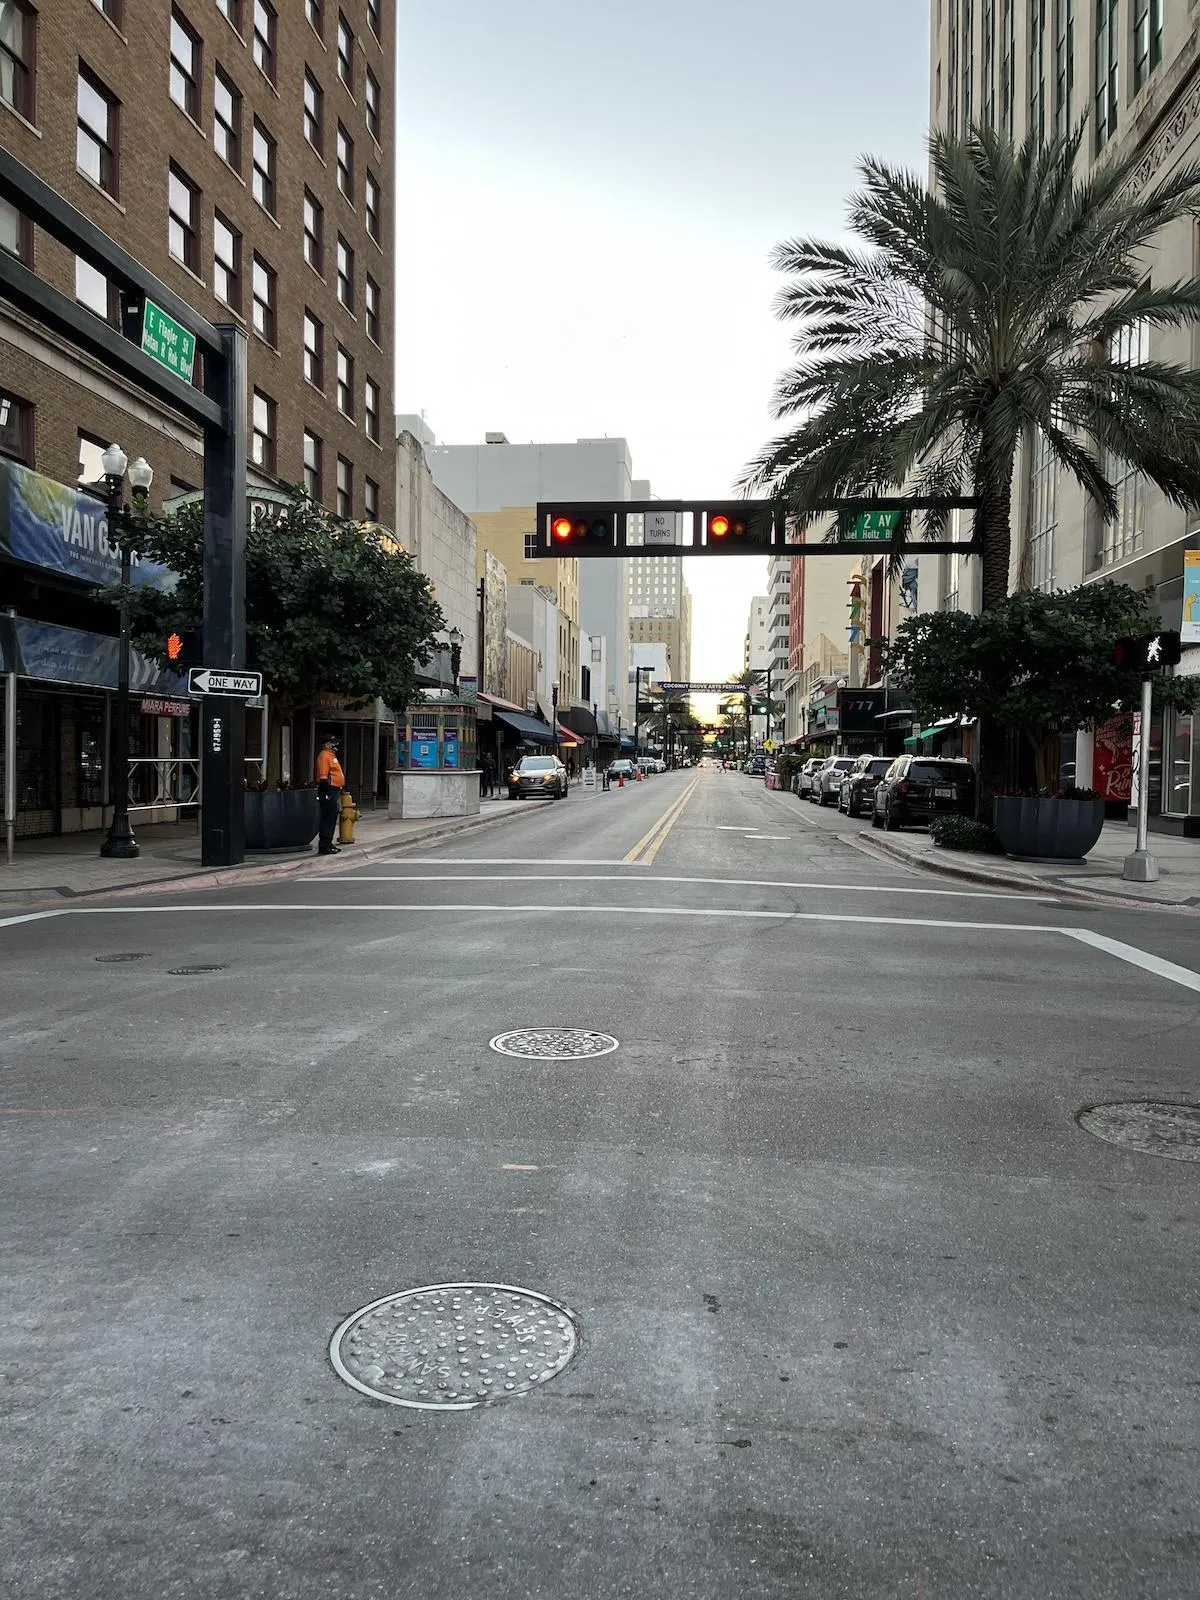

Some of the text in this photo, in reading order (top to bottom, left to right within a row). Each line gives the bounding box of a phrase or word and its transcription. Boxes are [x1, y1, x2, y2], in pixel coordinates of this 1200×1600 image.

[149, 311, 189, 355] E Flagler St
[160, 341, 166, 359] R
[180, 355, 192, 377] Blvd
[655, 517, 665, 526] NO
[863, 513, 871, 529] 2
[878, 514, 892, 528] AV
[61, 504, 95, 552] VAN
[650, 529, 671, 538] TURNS
[862, 529, 880, 540] Holtz
[208, 677, 255, 689] ONE WAY
[163, 701, 191, 714] PERFUME
[847, 701, 874, 710] 777
[474, 1304, 537, 1344] SEWER
